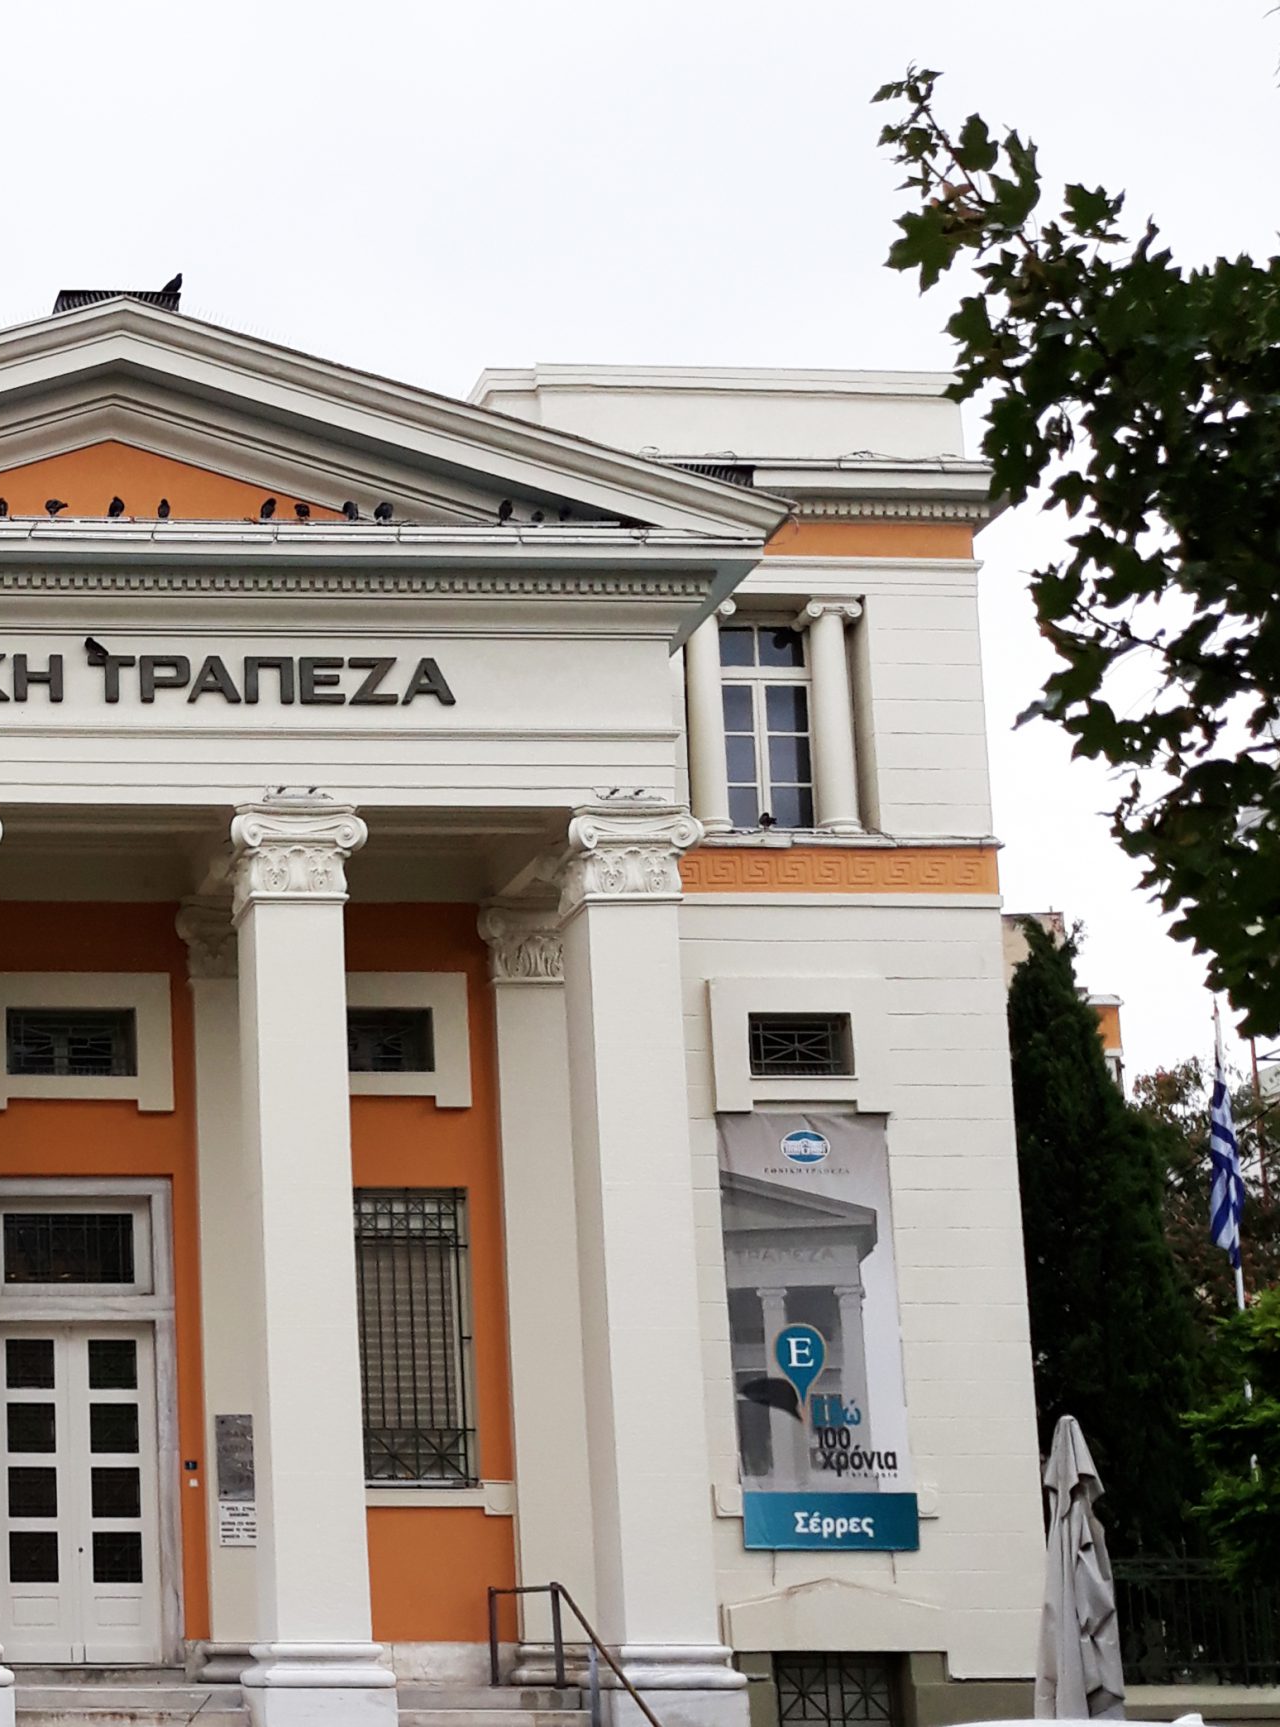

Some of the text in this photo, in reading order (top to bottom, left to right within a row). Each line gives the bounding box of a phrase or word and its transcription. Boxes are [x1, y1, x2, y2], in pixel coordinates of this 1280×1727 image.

[88, 654, 456, 706] ΤΡΑΠΕΖΑ
[817, 1426, 850, 1449] 100
[821, 1444, 897, 1477] χρόνια
[794, 1511, 874, 1538] Σέρρες
